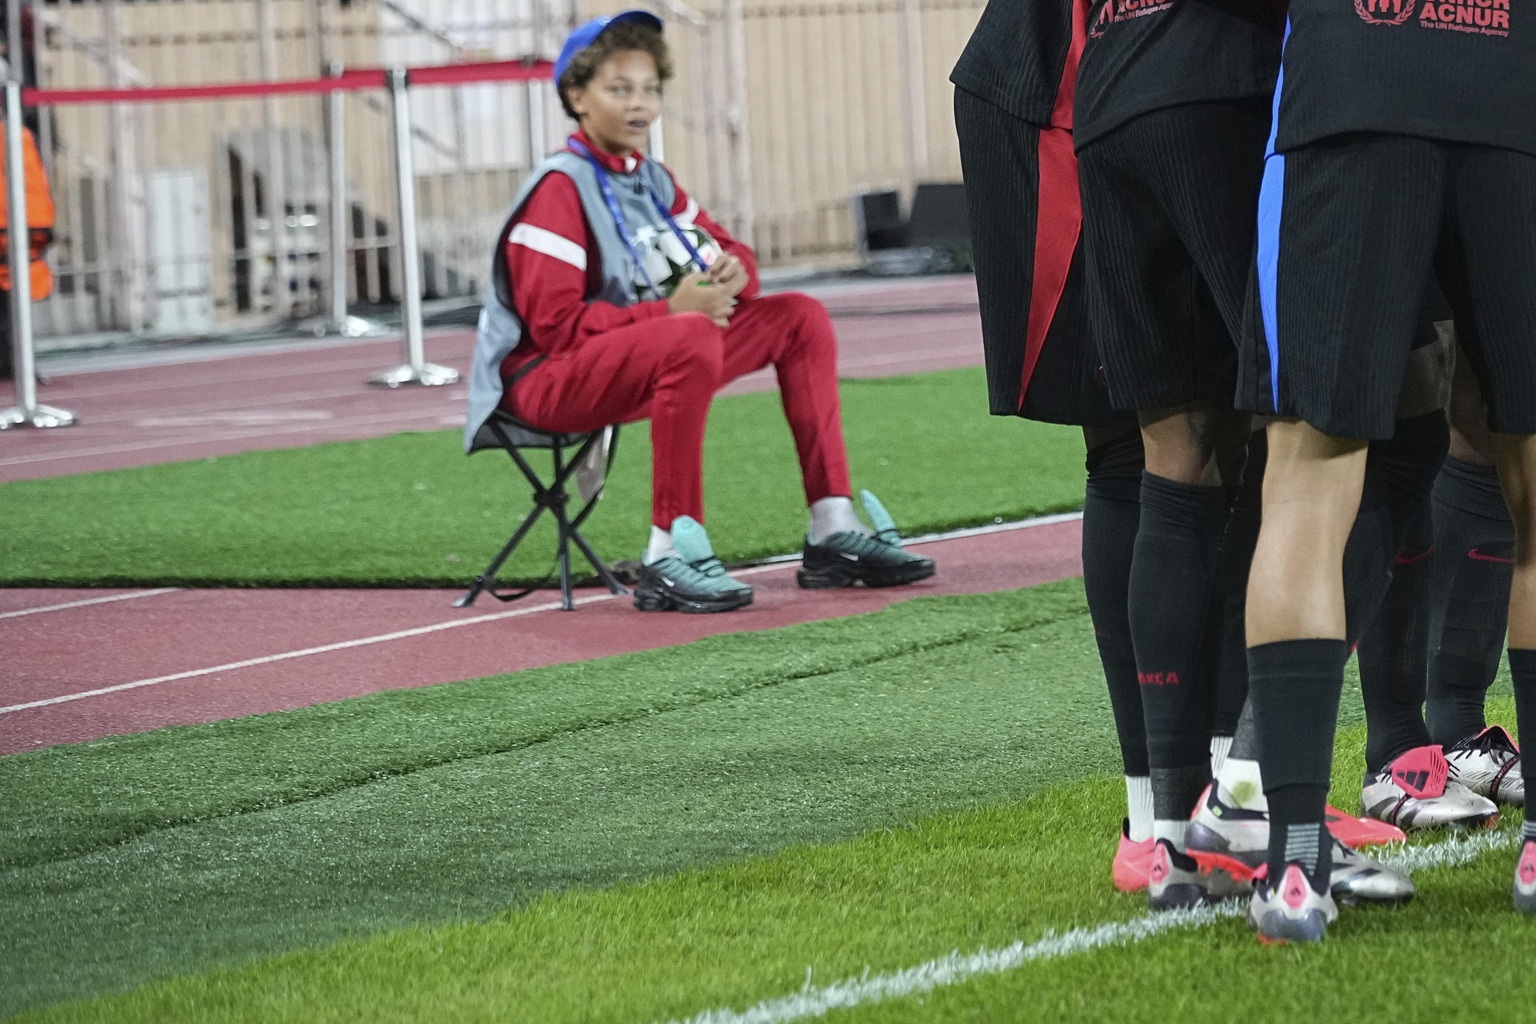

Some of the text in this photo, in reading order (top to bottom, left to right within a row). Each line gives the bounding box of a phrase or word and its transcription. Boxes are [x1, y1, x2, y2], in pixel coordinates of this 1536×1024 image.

[1419, 2, 1510, 29] ACNUR
[1420, 20, 1509, 38] The UN Refugee Agency
